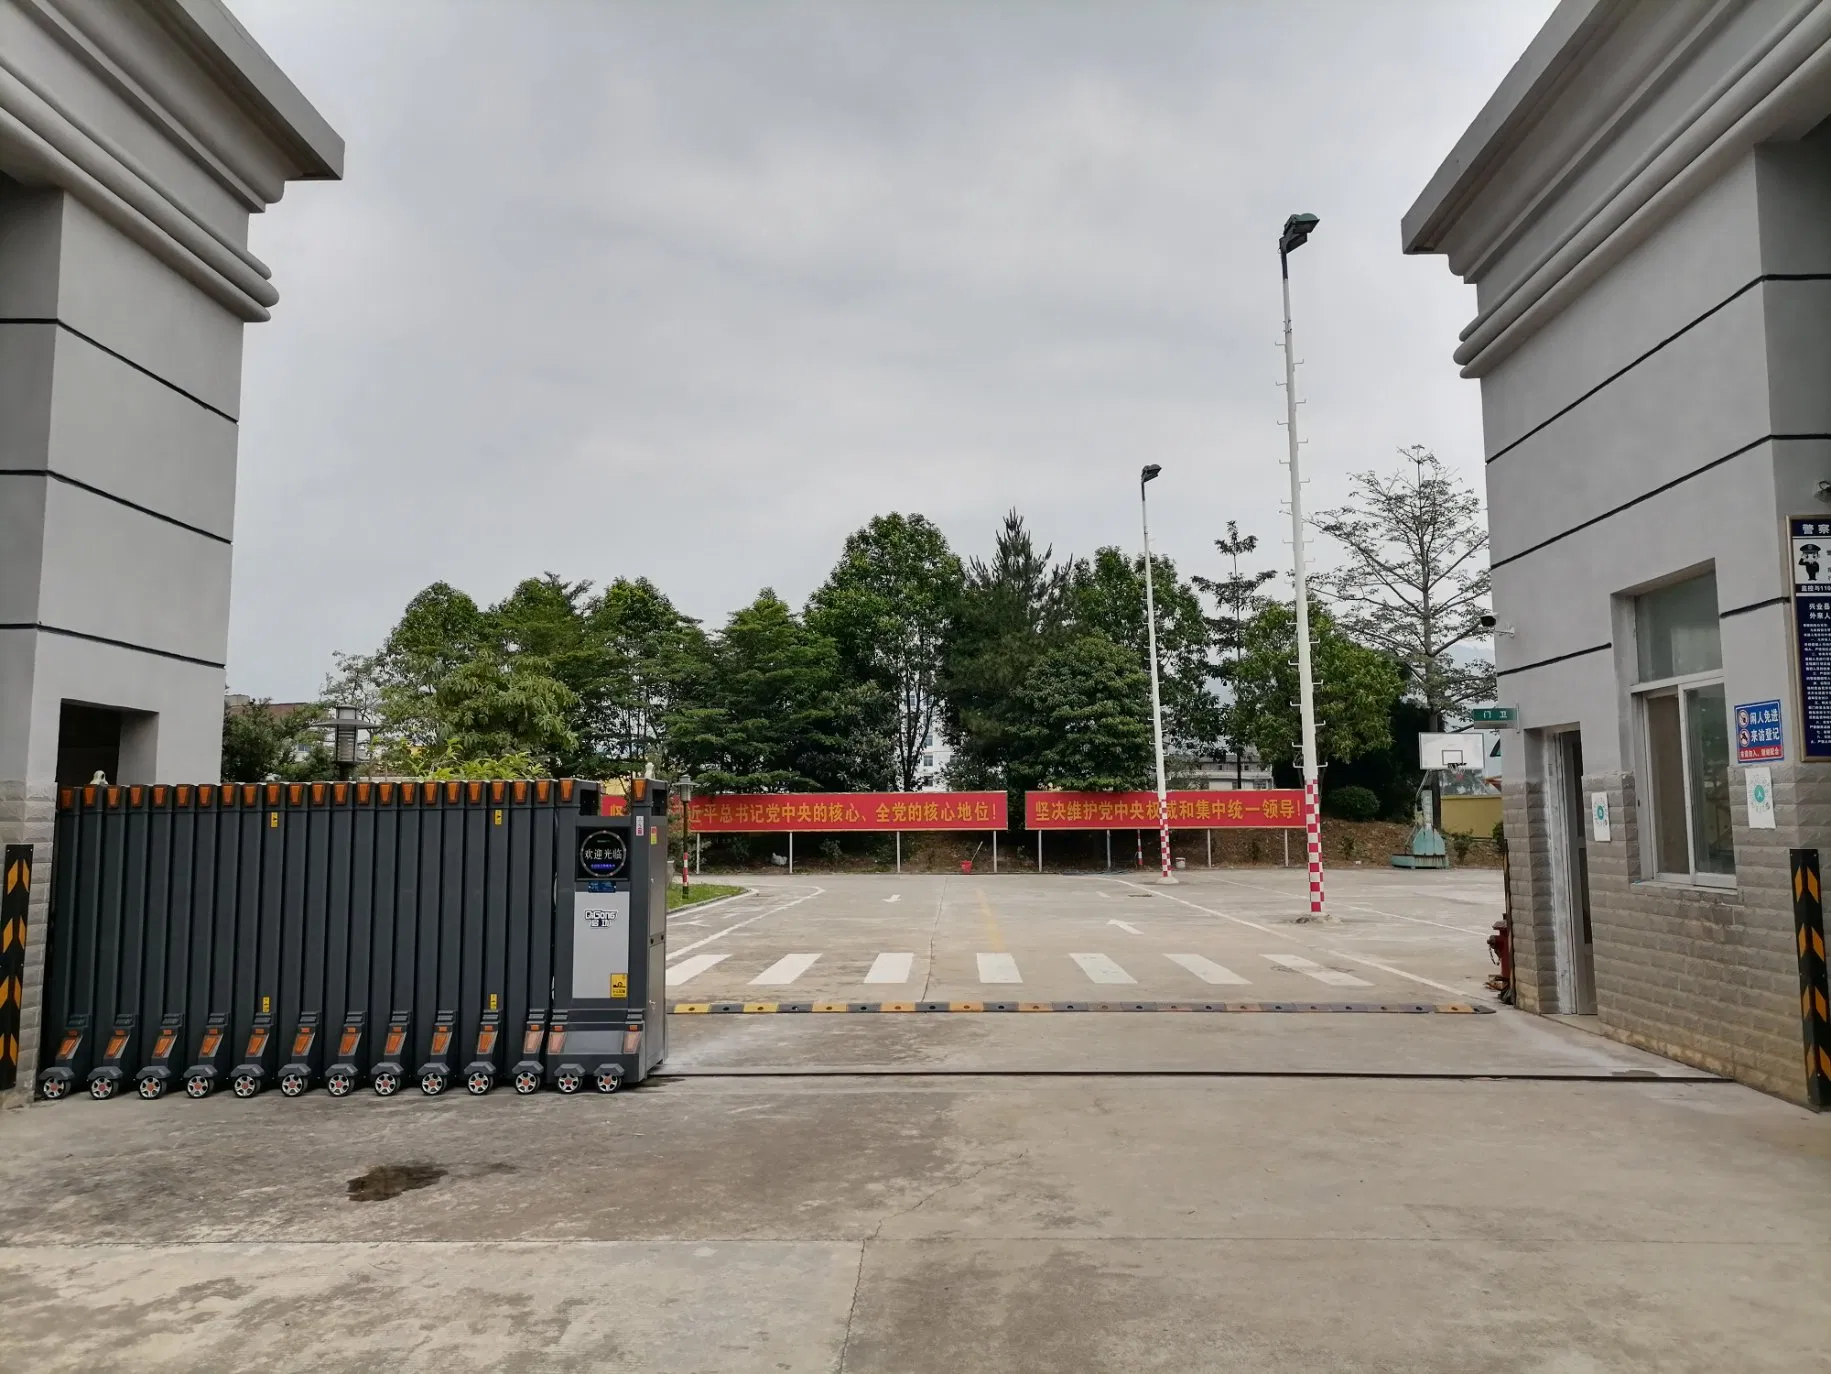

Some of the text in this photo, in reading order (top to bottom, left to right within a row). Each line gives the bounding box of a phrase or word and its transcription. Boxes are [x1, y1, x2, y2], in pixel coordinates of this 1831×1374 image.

[1751, 727, 1780, 743] 来访登记
[672, 801, 998, 825] 近平总书记党中央的核心、全党的核心地位!
[585, 848, 622, 860] 欢迎光临
